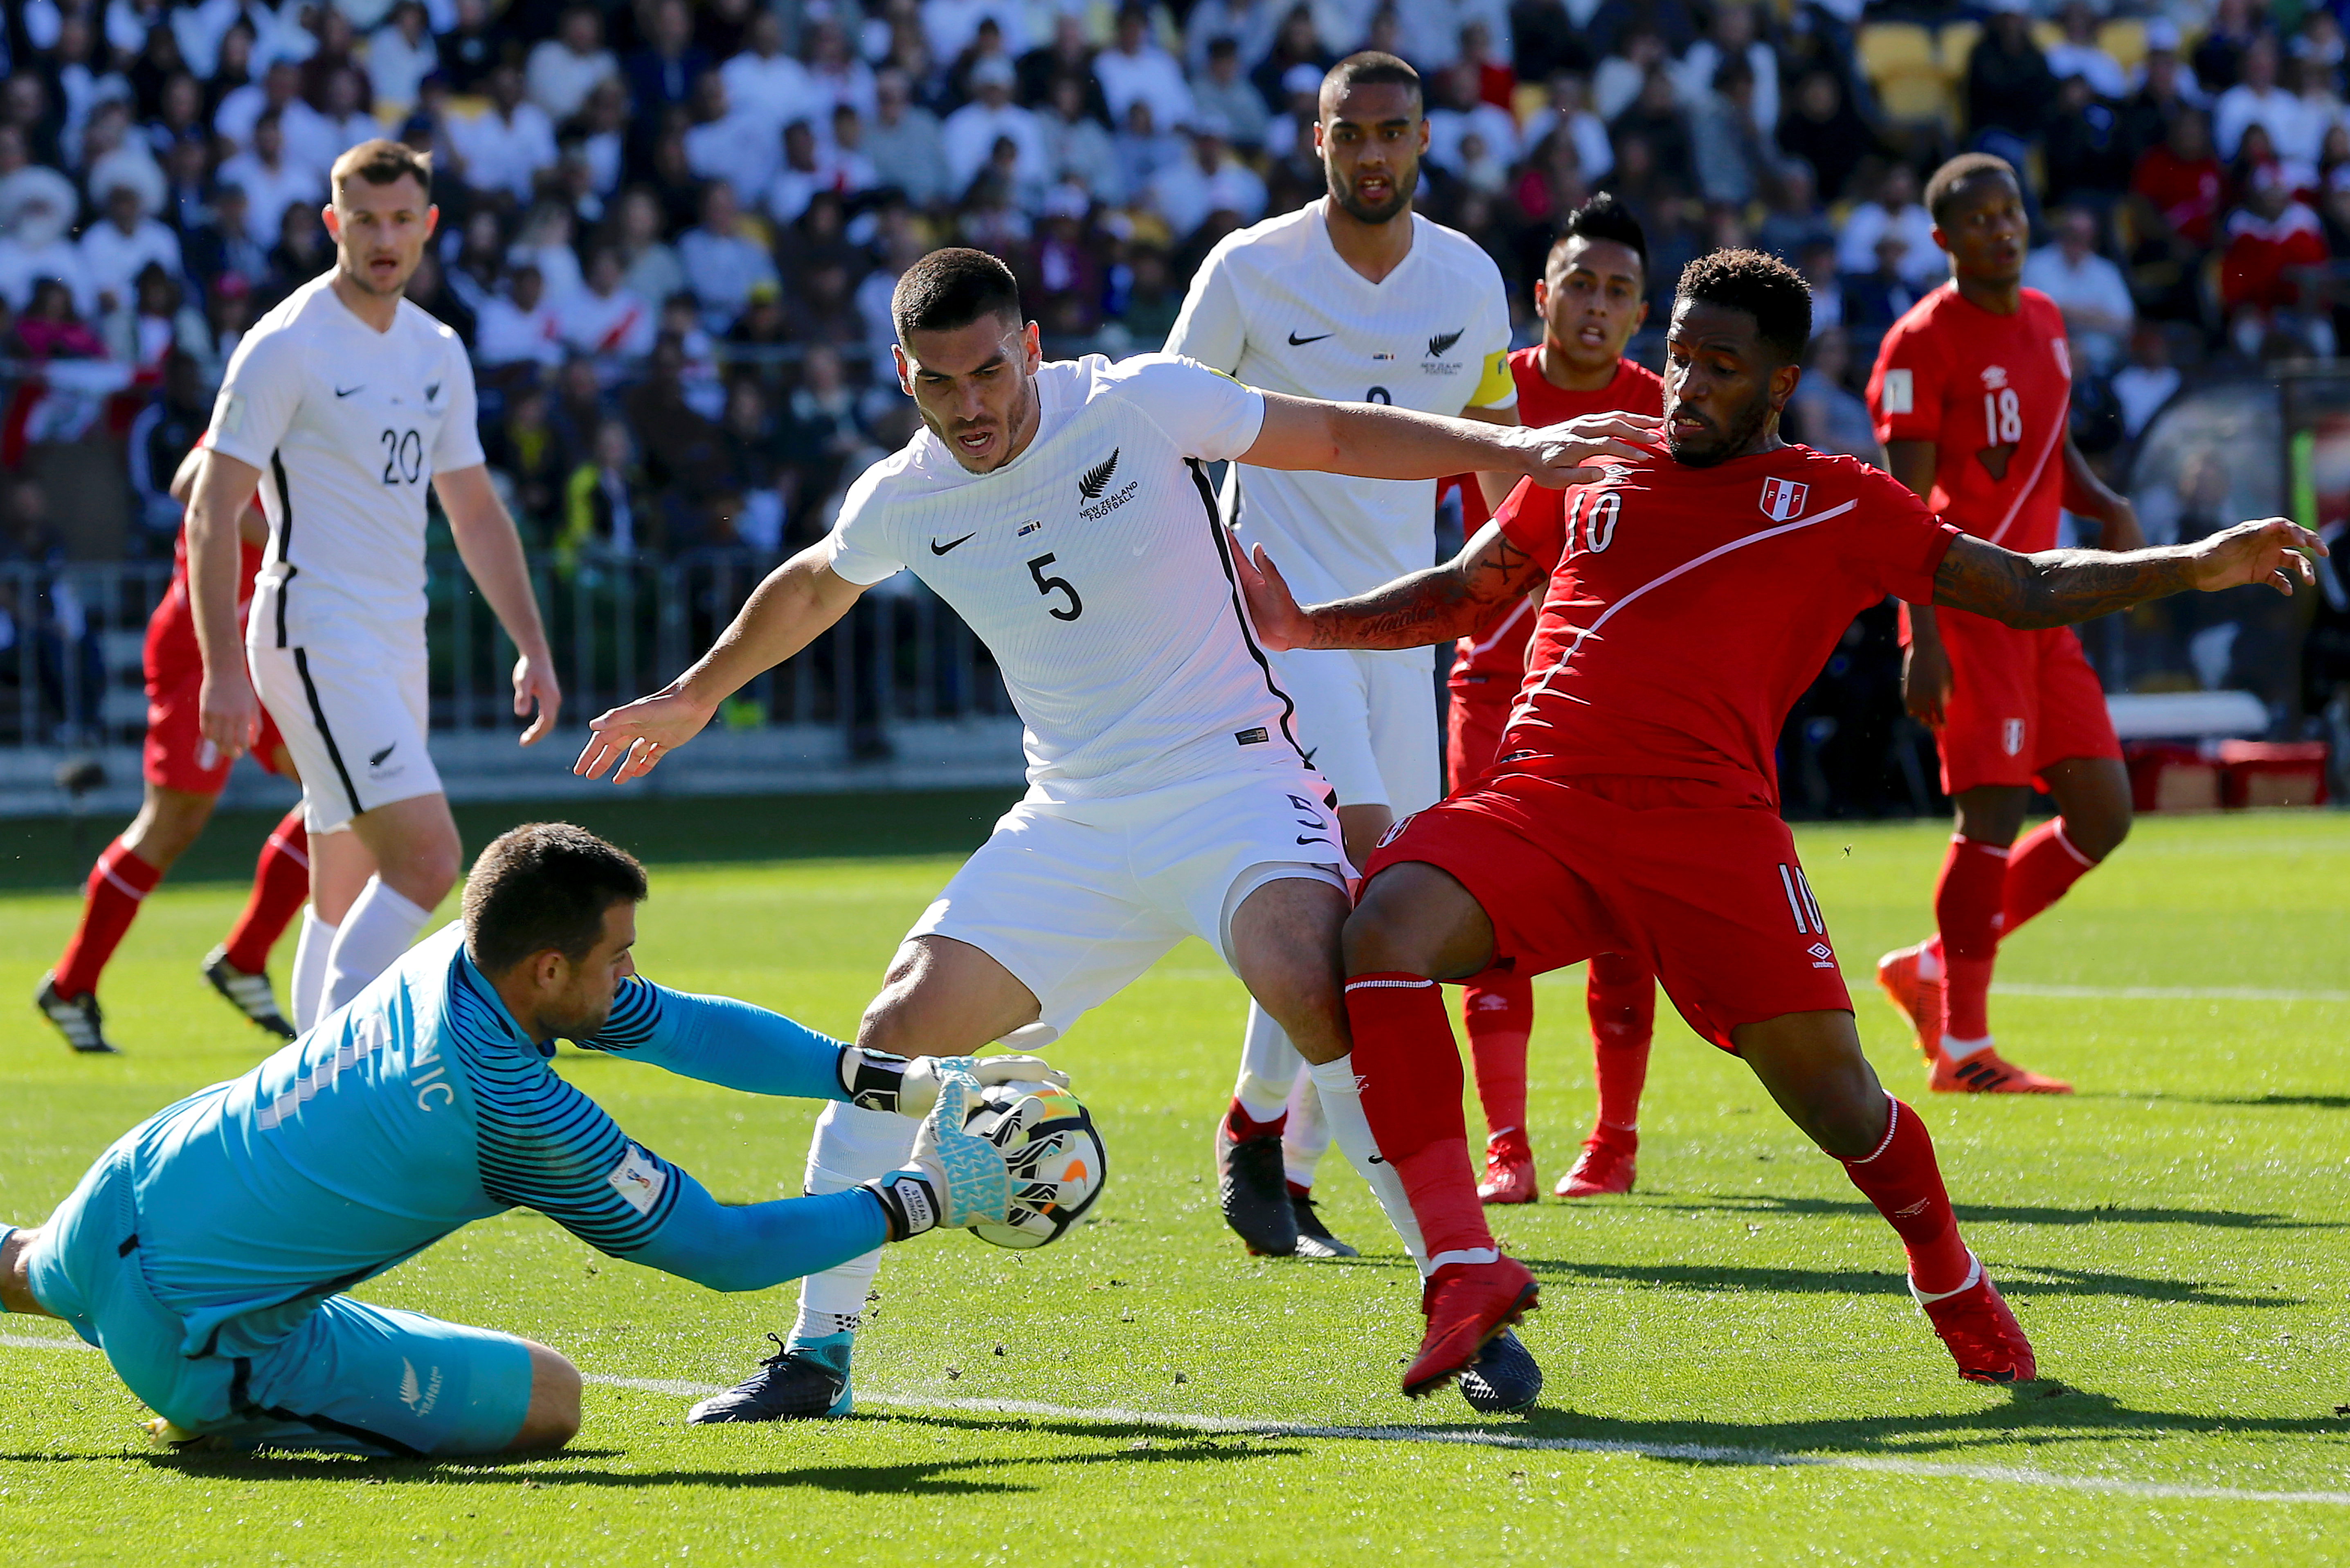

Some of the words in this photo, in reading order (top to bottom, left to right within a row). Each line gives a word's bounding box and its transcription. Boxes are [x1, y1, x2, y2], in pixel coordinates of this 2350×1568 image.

[1984, 388, 2022, 447] 18
[381, 429, 422, 484] 20
[1079, 505, 1099, 519] NEW
[1100, 481, 1138, 508] ZEALAND
[1089, 492, 1135, 521] FOOTBALL
[1567, 492, 1621, 559] 10
[1027, 552, 1083, 621] 5
[1779, 864, 1823, 935] 10
[912, 1190, 927, 1220] STEFAN
